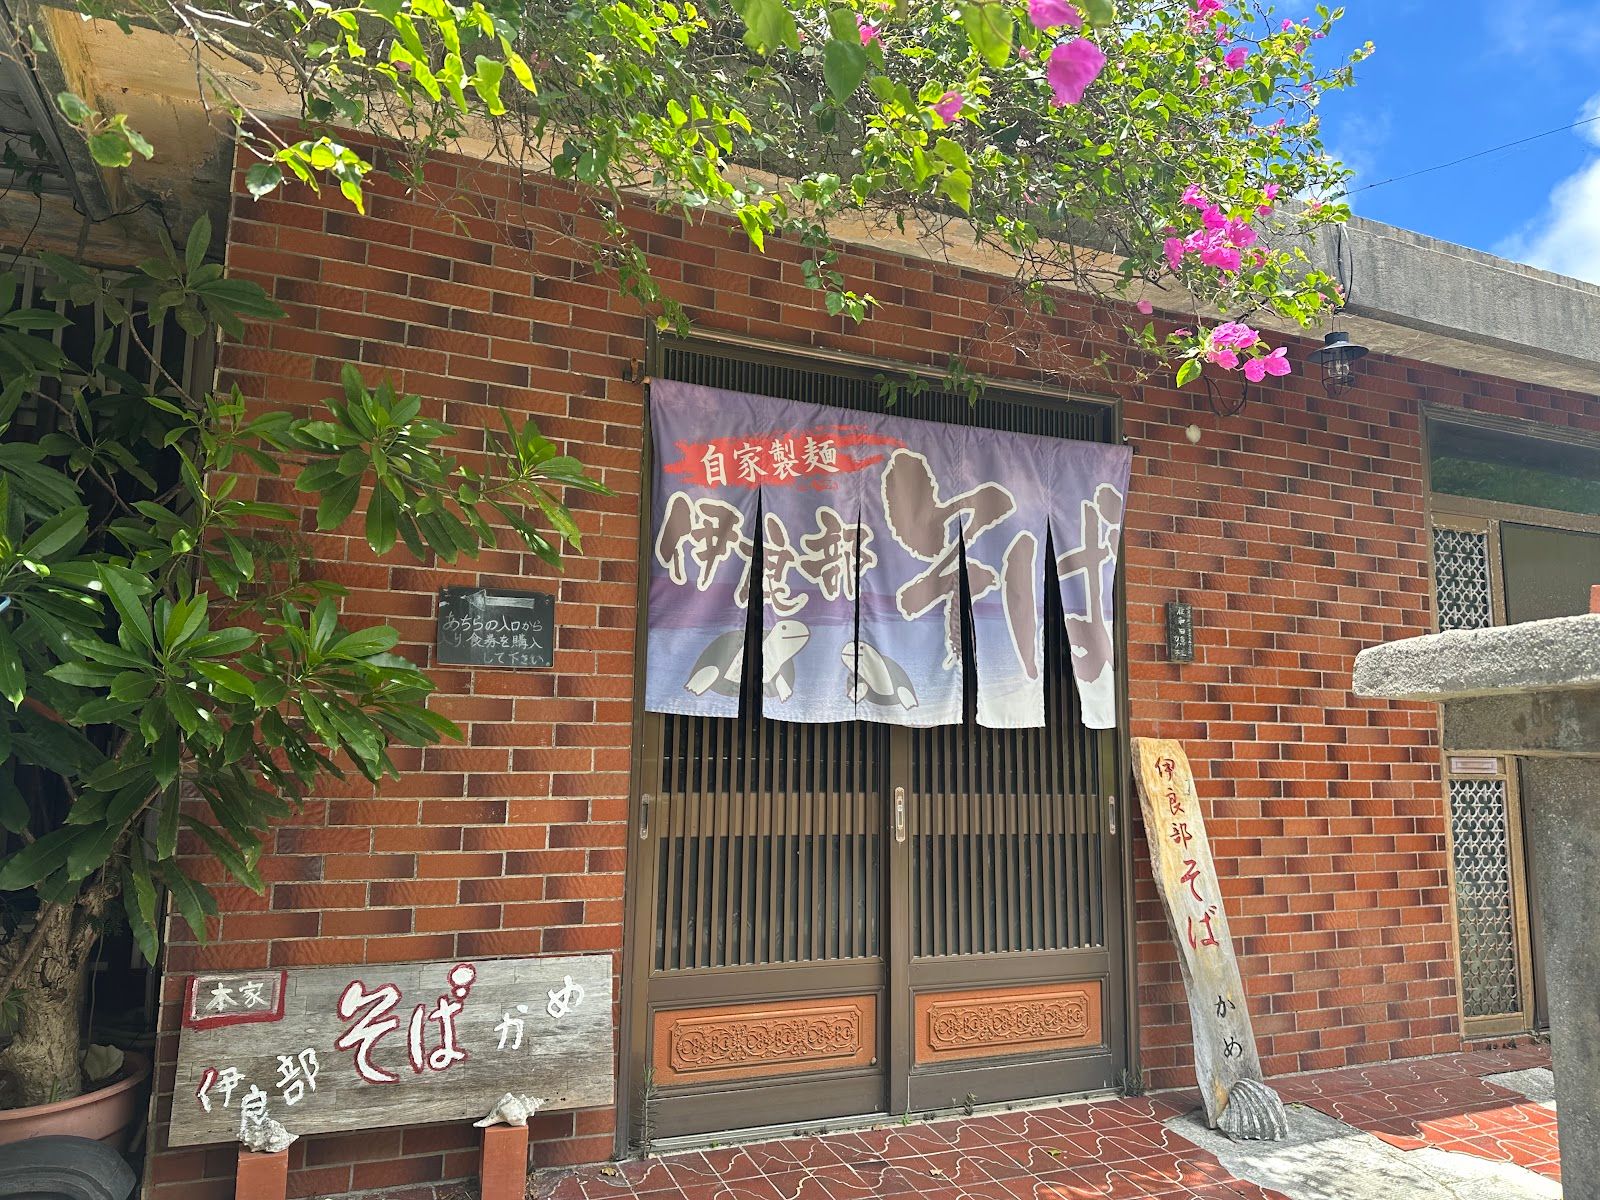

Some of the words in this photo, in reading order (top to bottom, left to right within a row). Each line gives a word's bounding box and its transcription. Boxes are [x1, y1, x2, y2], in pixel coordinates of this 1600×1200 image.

[700, 436, 840, 486] 自家製麺
[655, 491, 877, 616] 伊良部
[881, 448, 1123, 684] そば
[442, 611, 543, 632] あちらの入口から
[483, 652, 544, 665] して下さい
[205, 981, 269, 1012] 本家
[1214, 995, 1243, 1060] かめ
[196, 1048, 319, 1128] 伊良部
